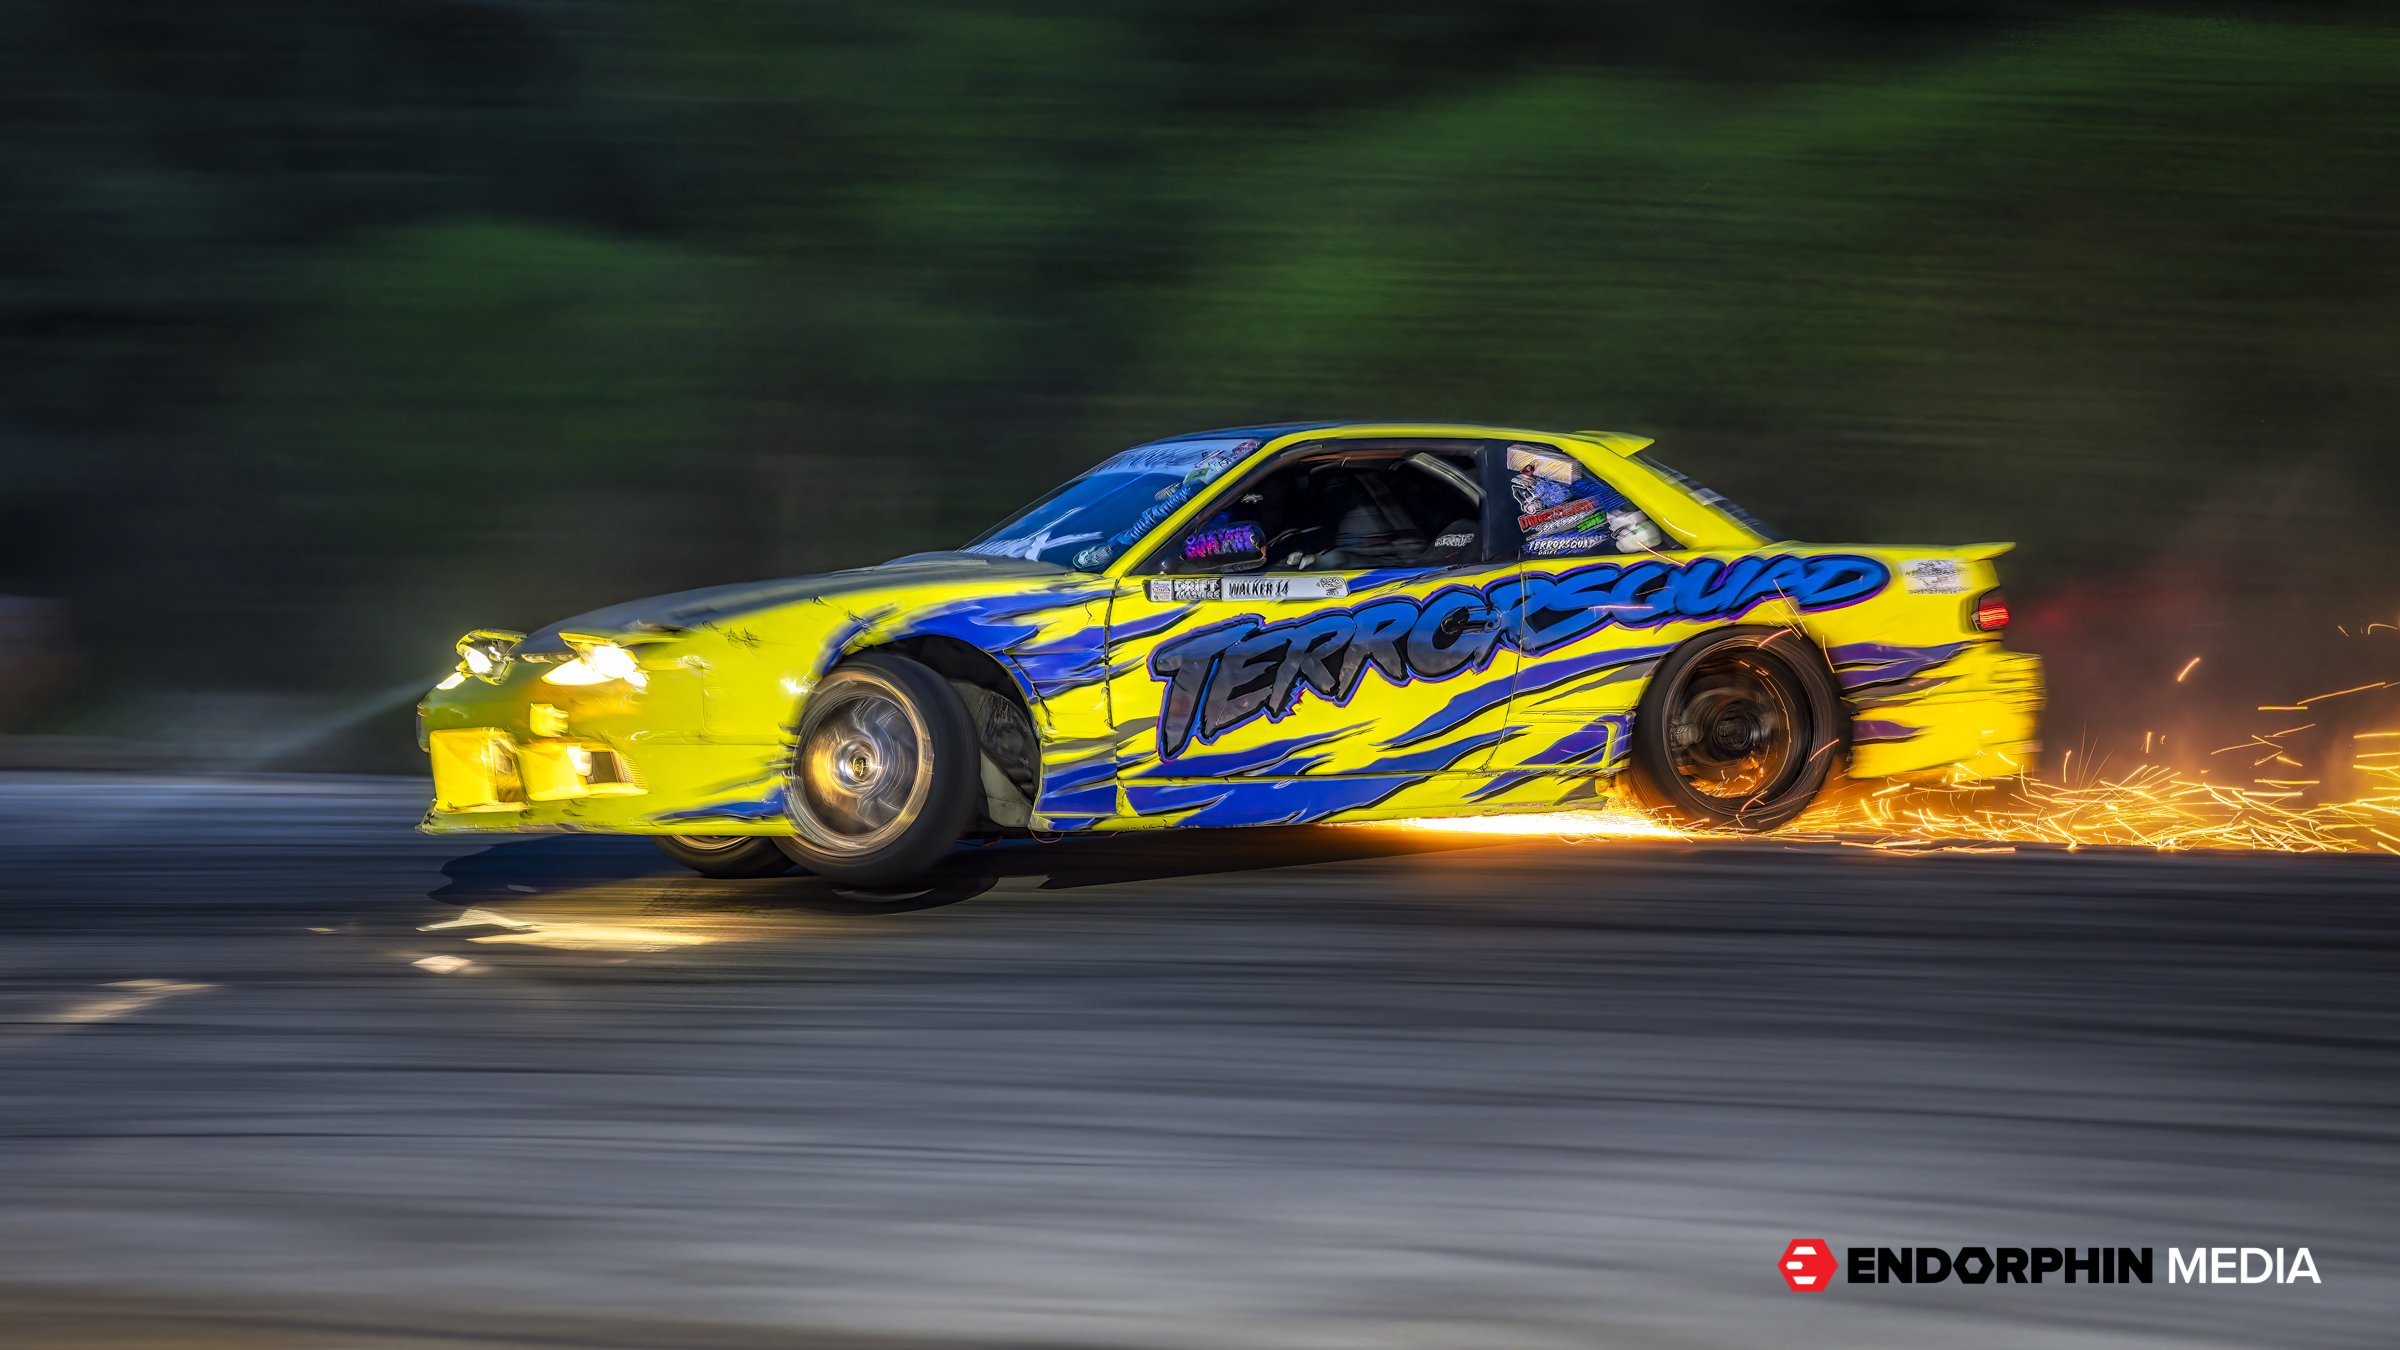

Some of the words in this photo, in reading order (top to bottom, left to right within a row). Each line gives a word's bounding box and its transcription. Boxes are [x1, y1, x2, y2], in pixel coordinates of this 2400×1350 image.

[1228, 580, 1272, 597] WALKER
[1275, 579, 1289, 596] 14
[1148, 553, 1890, 762] TERRORSQUAD
